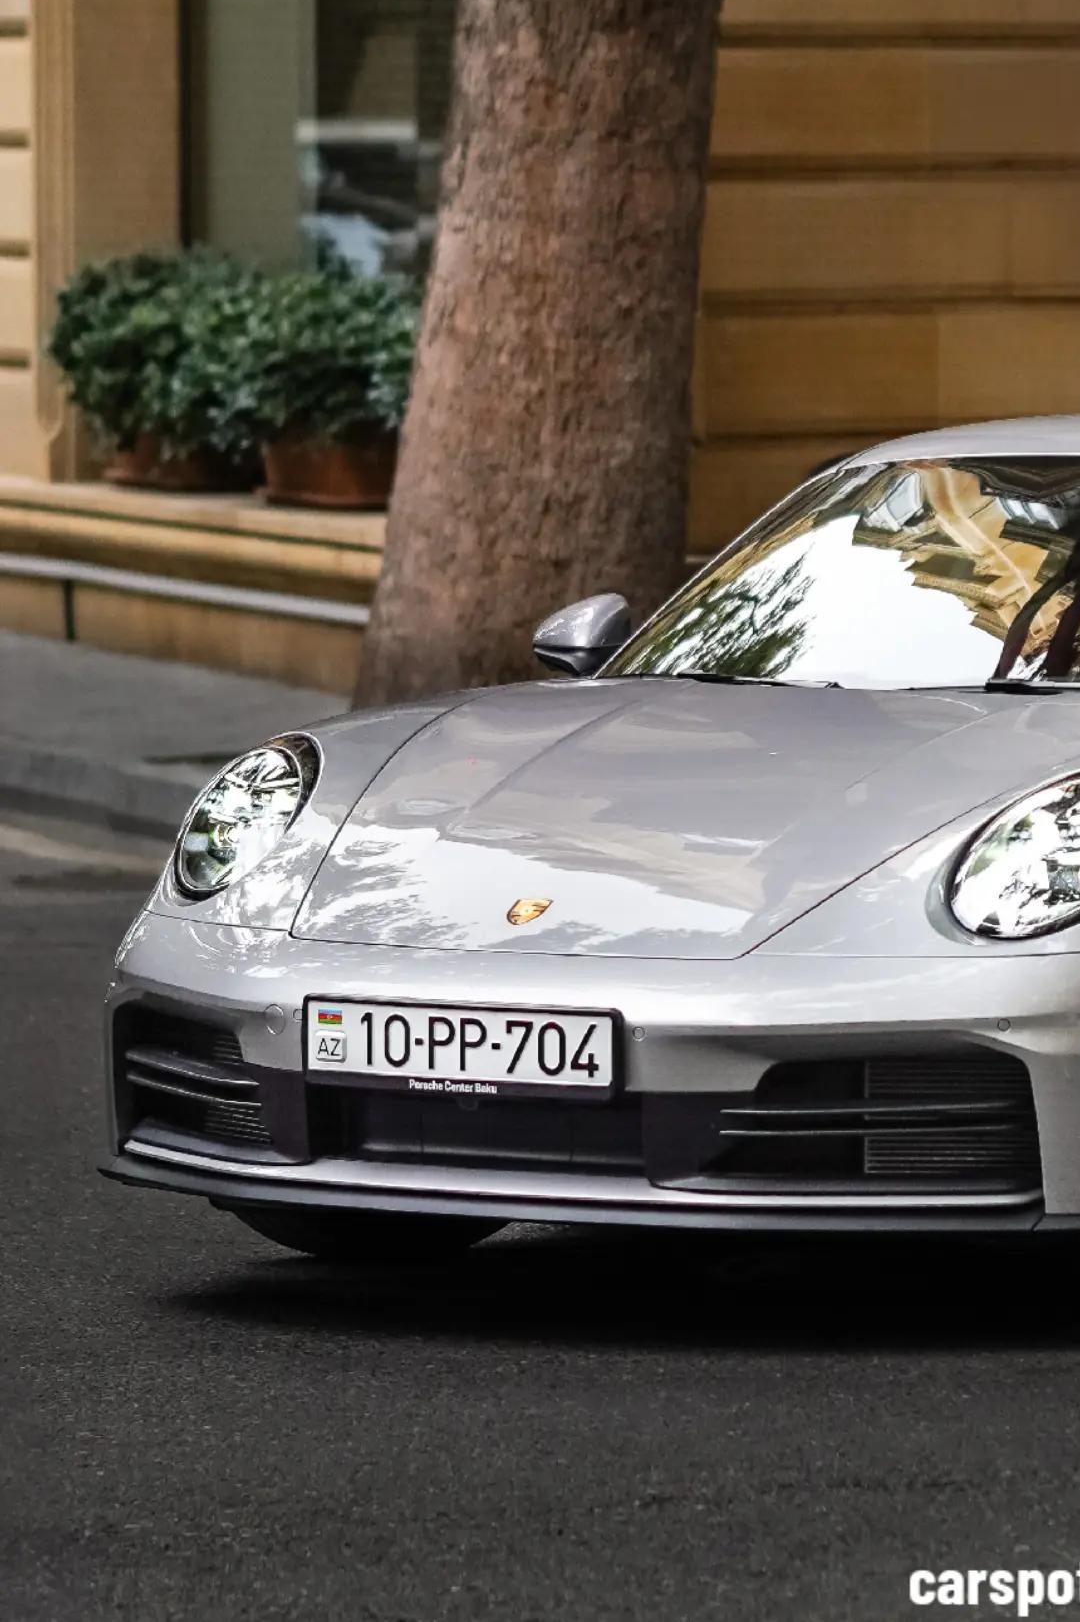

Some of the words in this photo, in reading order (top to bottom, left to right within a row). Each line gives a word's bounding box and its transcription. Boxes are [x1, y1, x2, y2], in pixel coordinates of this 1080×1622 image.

[317, 1037, 341, 1057] AZ
[360, 1011, 600, 1078] 10-PP-704
[409, 1079, 443, 1091] Porsche
[444, 1081, 473, 1093] Center
[474, 1083, 498, 1094] Baku
